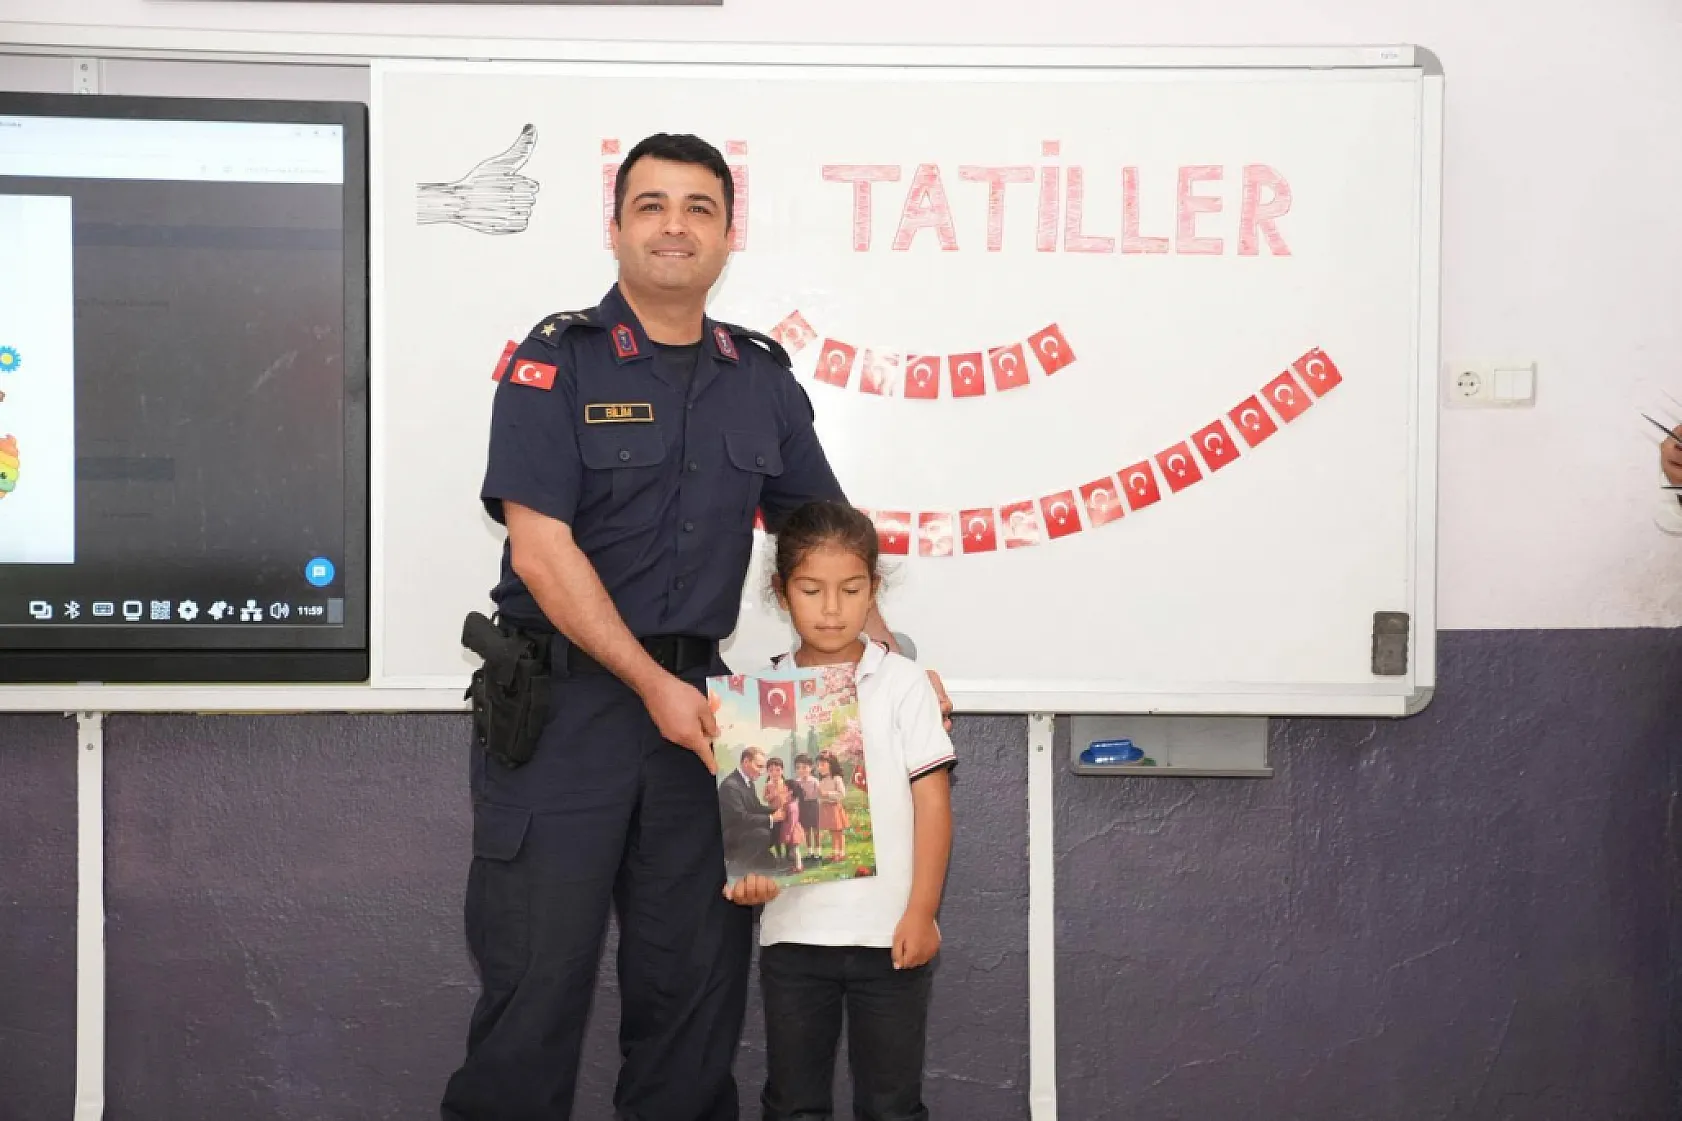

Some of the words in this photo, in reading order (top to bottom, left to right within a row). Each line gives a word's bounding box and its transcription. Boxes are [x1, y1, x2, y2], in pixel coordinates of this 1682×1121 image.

[601, 138, 749, 252] İİ
[821, 140, 1293, 256] TATİLLER
[297, 605, 323, 616] 11:59
